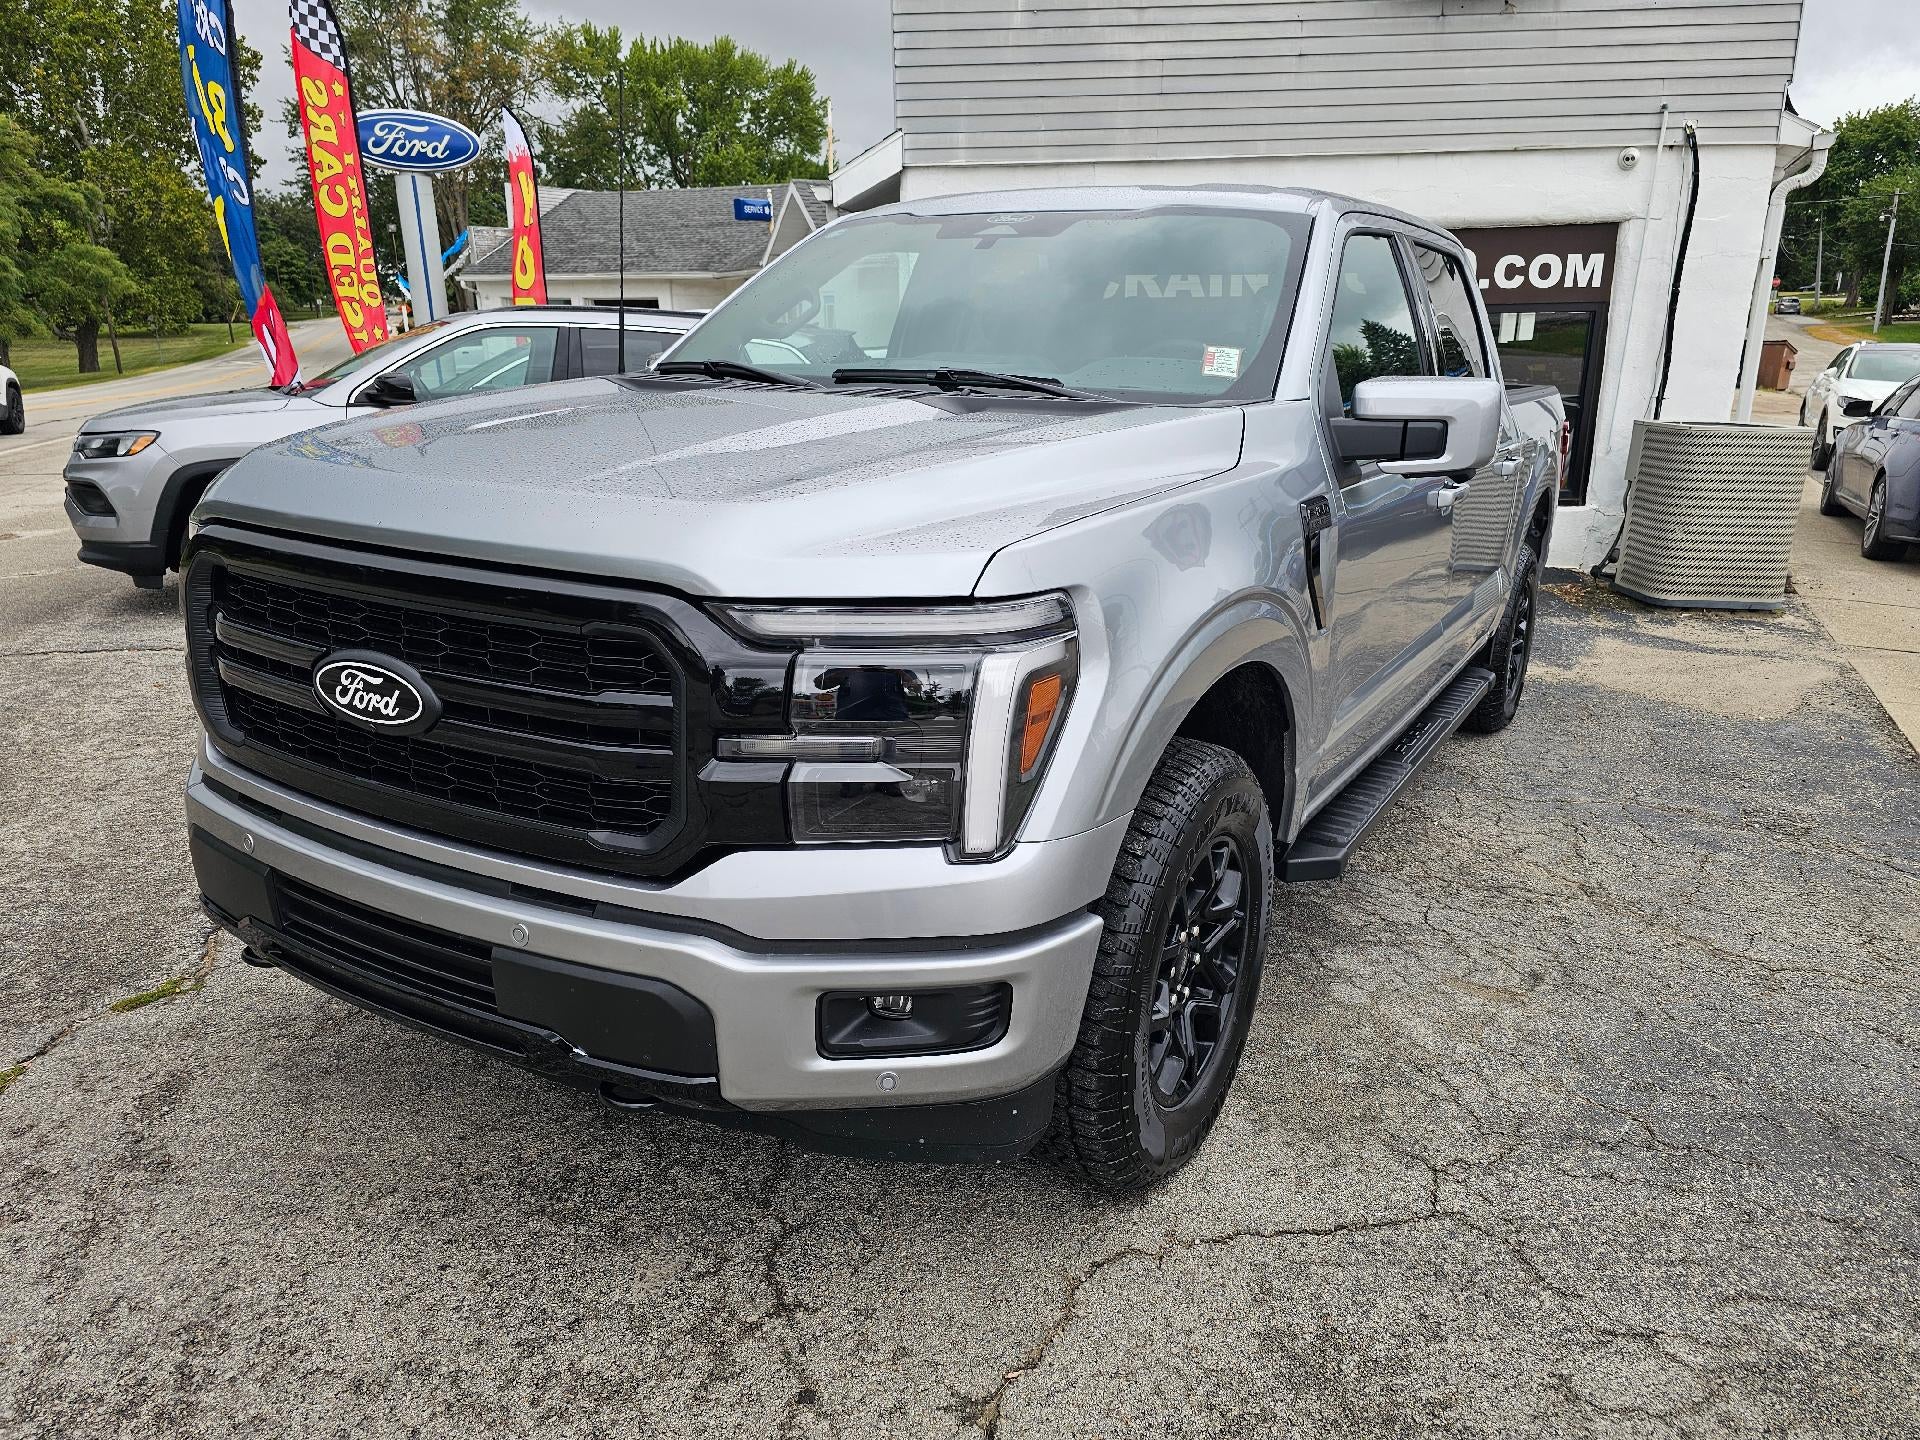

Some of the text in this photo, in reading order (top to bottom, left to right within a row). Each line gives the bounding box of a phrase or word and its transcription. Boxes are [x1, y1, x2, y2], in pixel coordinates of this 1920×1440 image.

[367, 121, 451, 159] Ford
[743, 205, 764, 215] SERVICE
[335, 668, 401, 717] Ford
